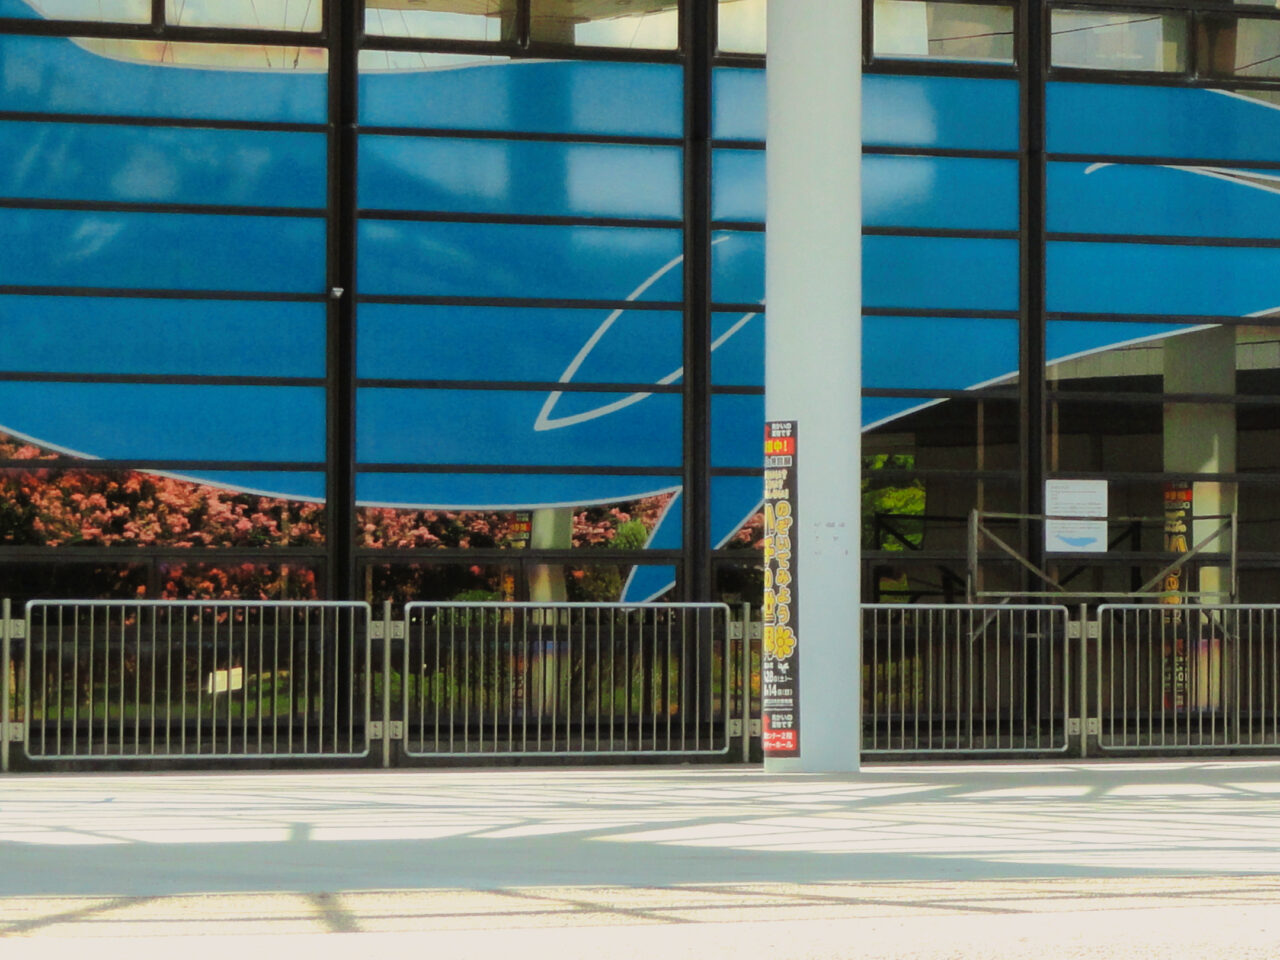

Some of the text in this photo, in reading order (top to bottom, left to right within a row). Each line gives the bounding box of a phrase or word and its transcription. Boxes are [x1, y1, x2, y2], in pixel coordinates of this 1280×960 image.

[776, 501, 793, 623] のぞいてみよう
